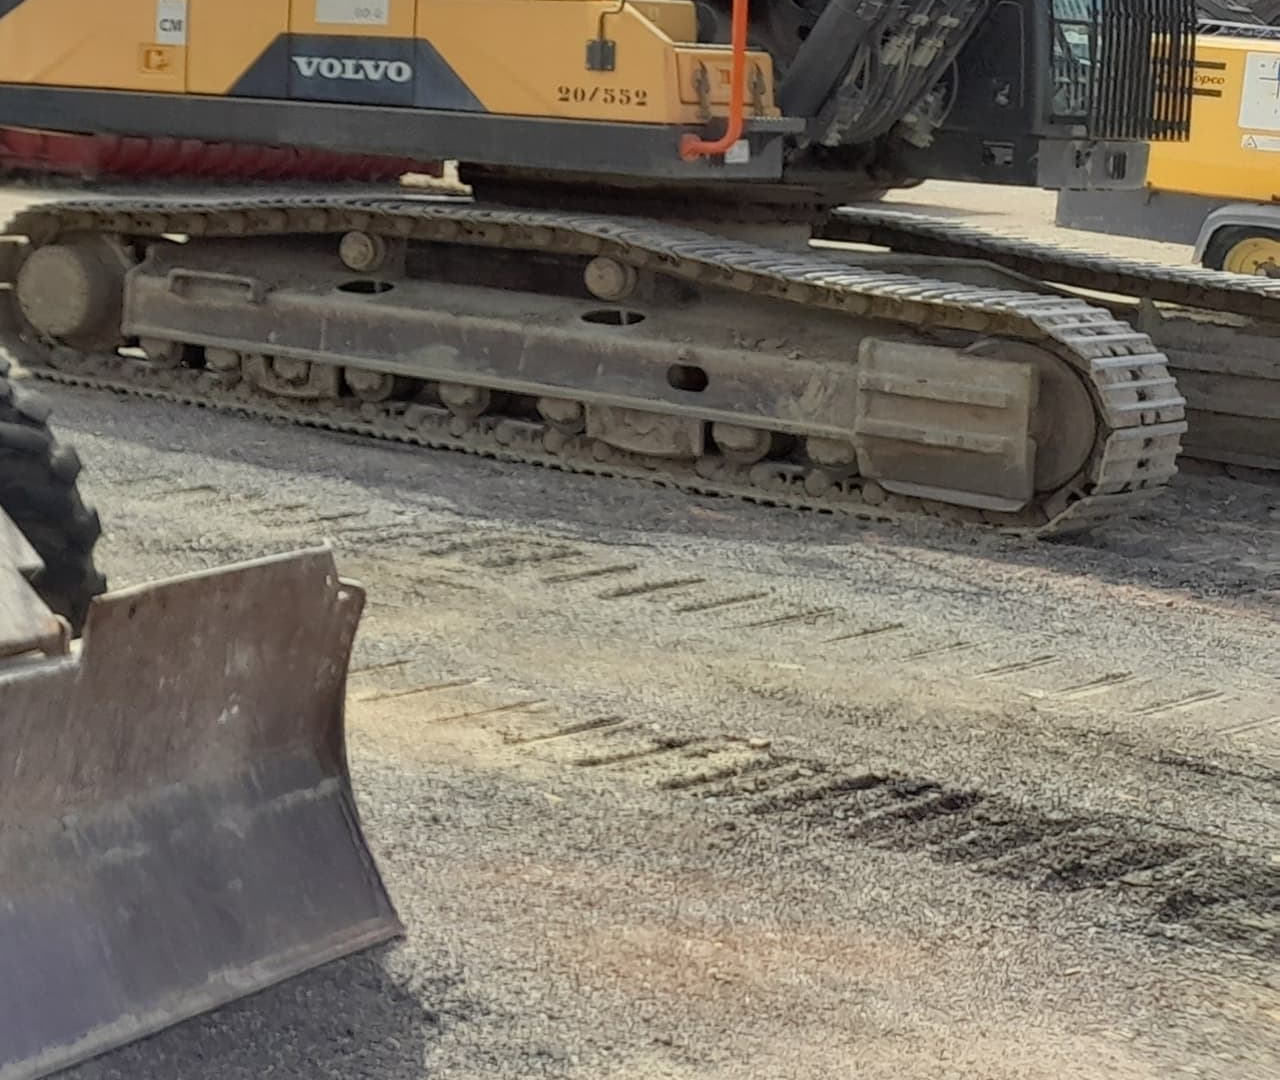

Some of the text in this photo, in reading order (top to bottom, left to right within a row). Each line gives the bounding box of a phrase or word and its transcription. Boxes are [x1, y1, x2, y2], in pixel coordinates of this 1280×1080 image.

[292, 56, 412, 82] VOLVO
[1194, 70, 1225, 86] opco
[557, 85, 647, 106] 20/552
